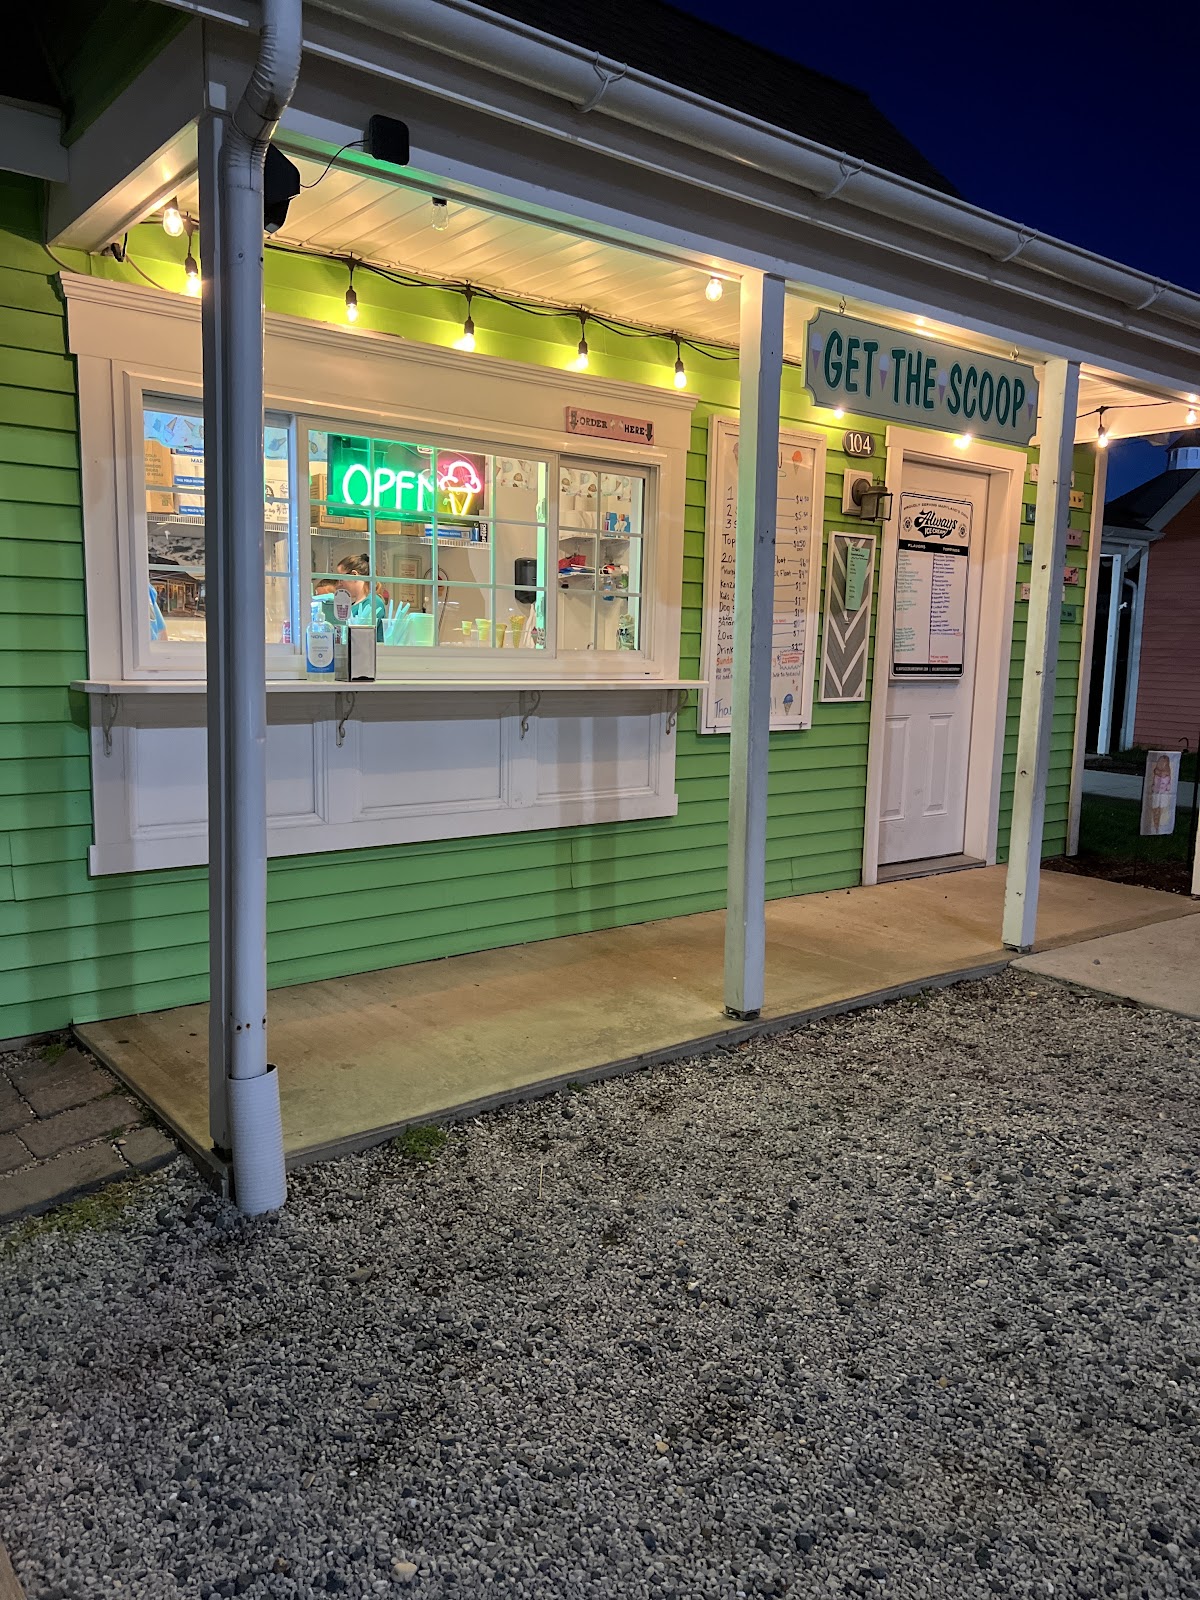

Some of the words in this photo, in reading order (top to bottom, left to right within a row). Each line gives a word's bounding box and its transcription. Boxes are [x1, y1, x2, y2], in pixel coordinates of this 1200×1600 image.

[823, 330, 880, 398] GET
[891, 349, 937, 410] THE
[947, 362, 1026, 428] SCOOP
[579, 416, 608, 429] ORDER
[624, 424, 645, 436] HERE
[849, 432, 872, 455] 104
[342, 463, 440, 512] OPEN
[914, 509, 958, 530] Always
